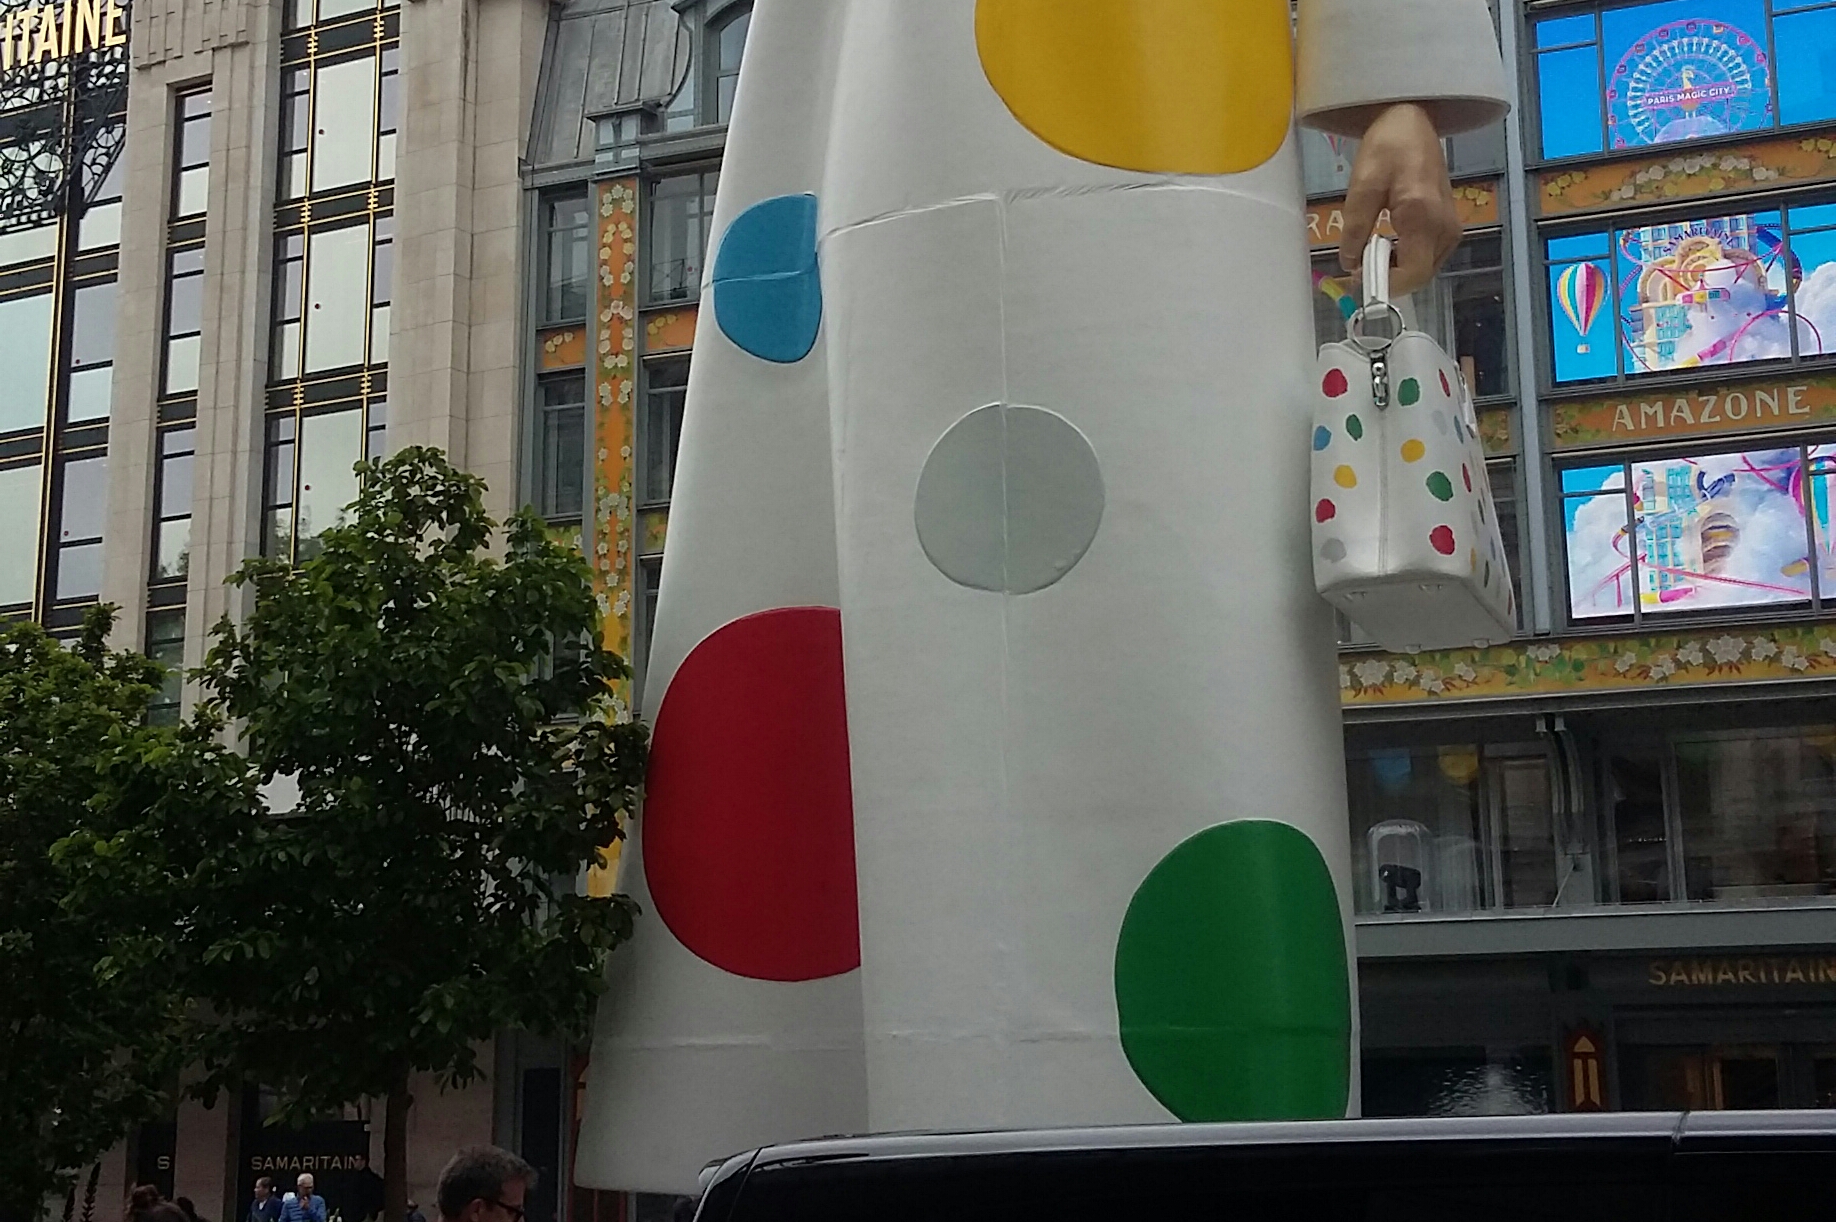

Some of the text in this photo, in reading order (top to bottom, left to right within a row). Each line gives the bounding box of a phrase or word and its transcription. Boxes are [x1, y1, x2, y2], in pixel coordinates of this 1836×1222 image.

[1648, 86, 1730, 105] PARIS MAGIC CITY
[1612, 386, 1810, 431] AMAZONE
